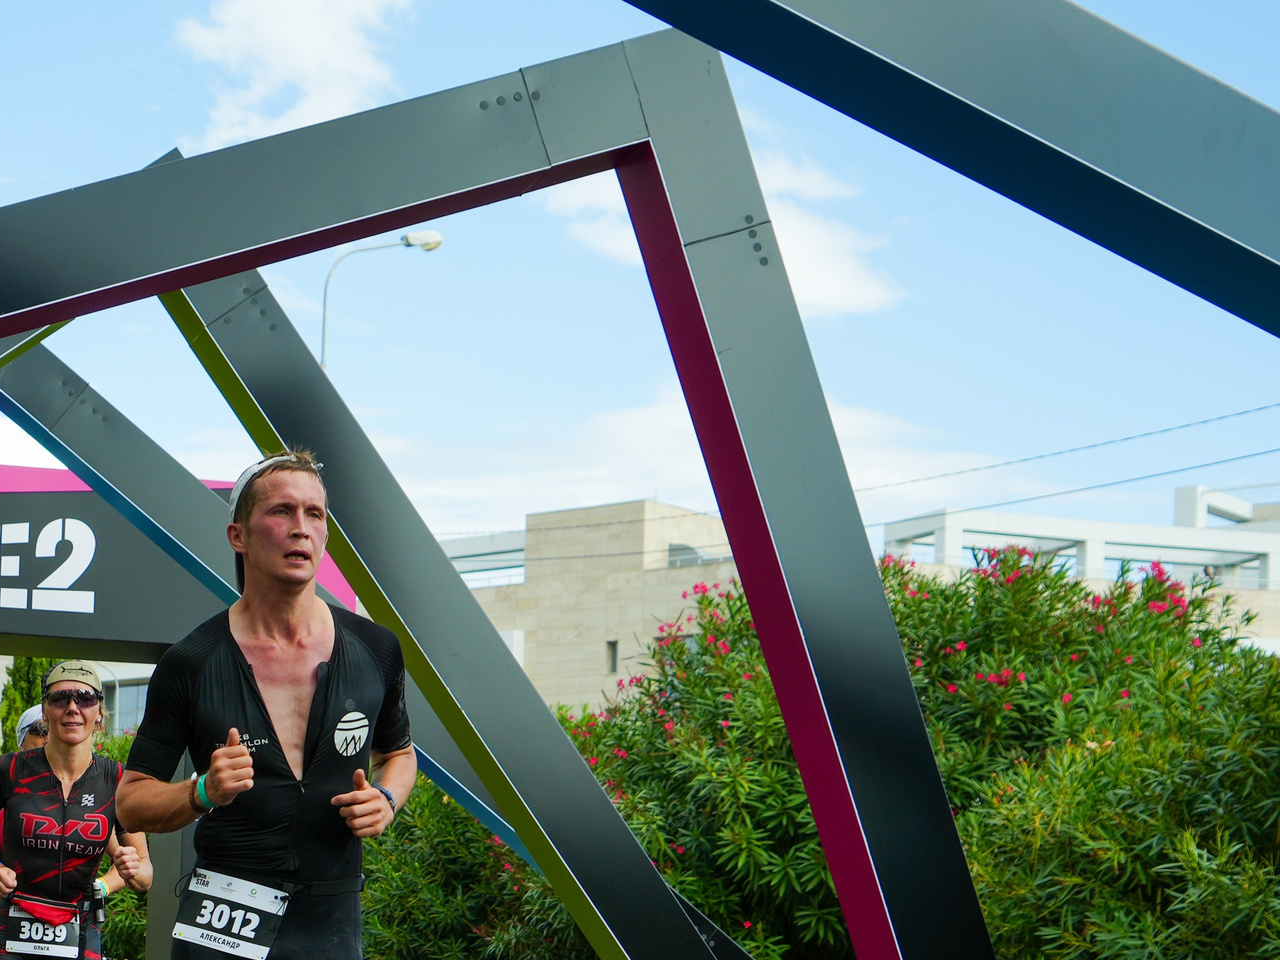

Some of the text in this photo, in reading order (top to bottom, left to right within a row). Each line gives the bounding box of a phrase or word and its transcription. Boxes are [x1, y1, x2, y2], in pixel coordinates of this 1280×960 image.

[22, 838, 105, 855] IRON TEAM
[195, 878, 210, 888] STAR
[195, 899, 261, 939] 3012
[19, 920, 68, 943] 3039
[33, 944, 50, 952] ОЛЬГА
[199, 932, 241, 950] АЛЕКСАНДР
